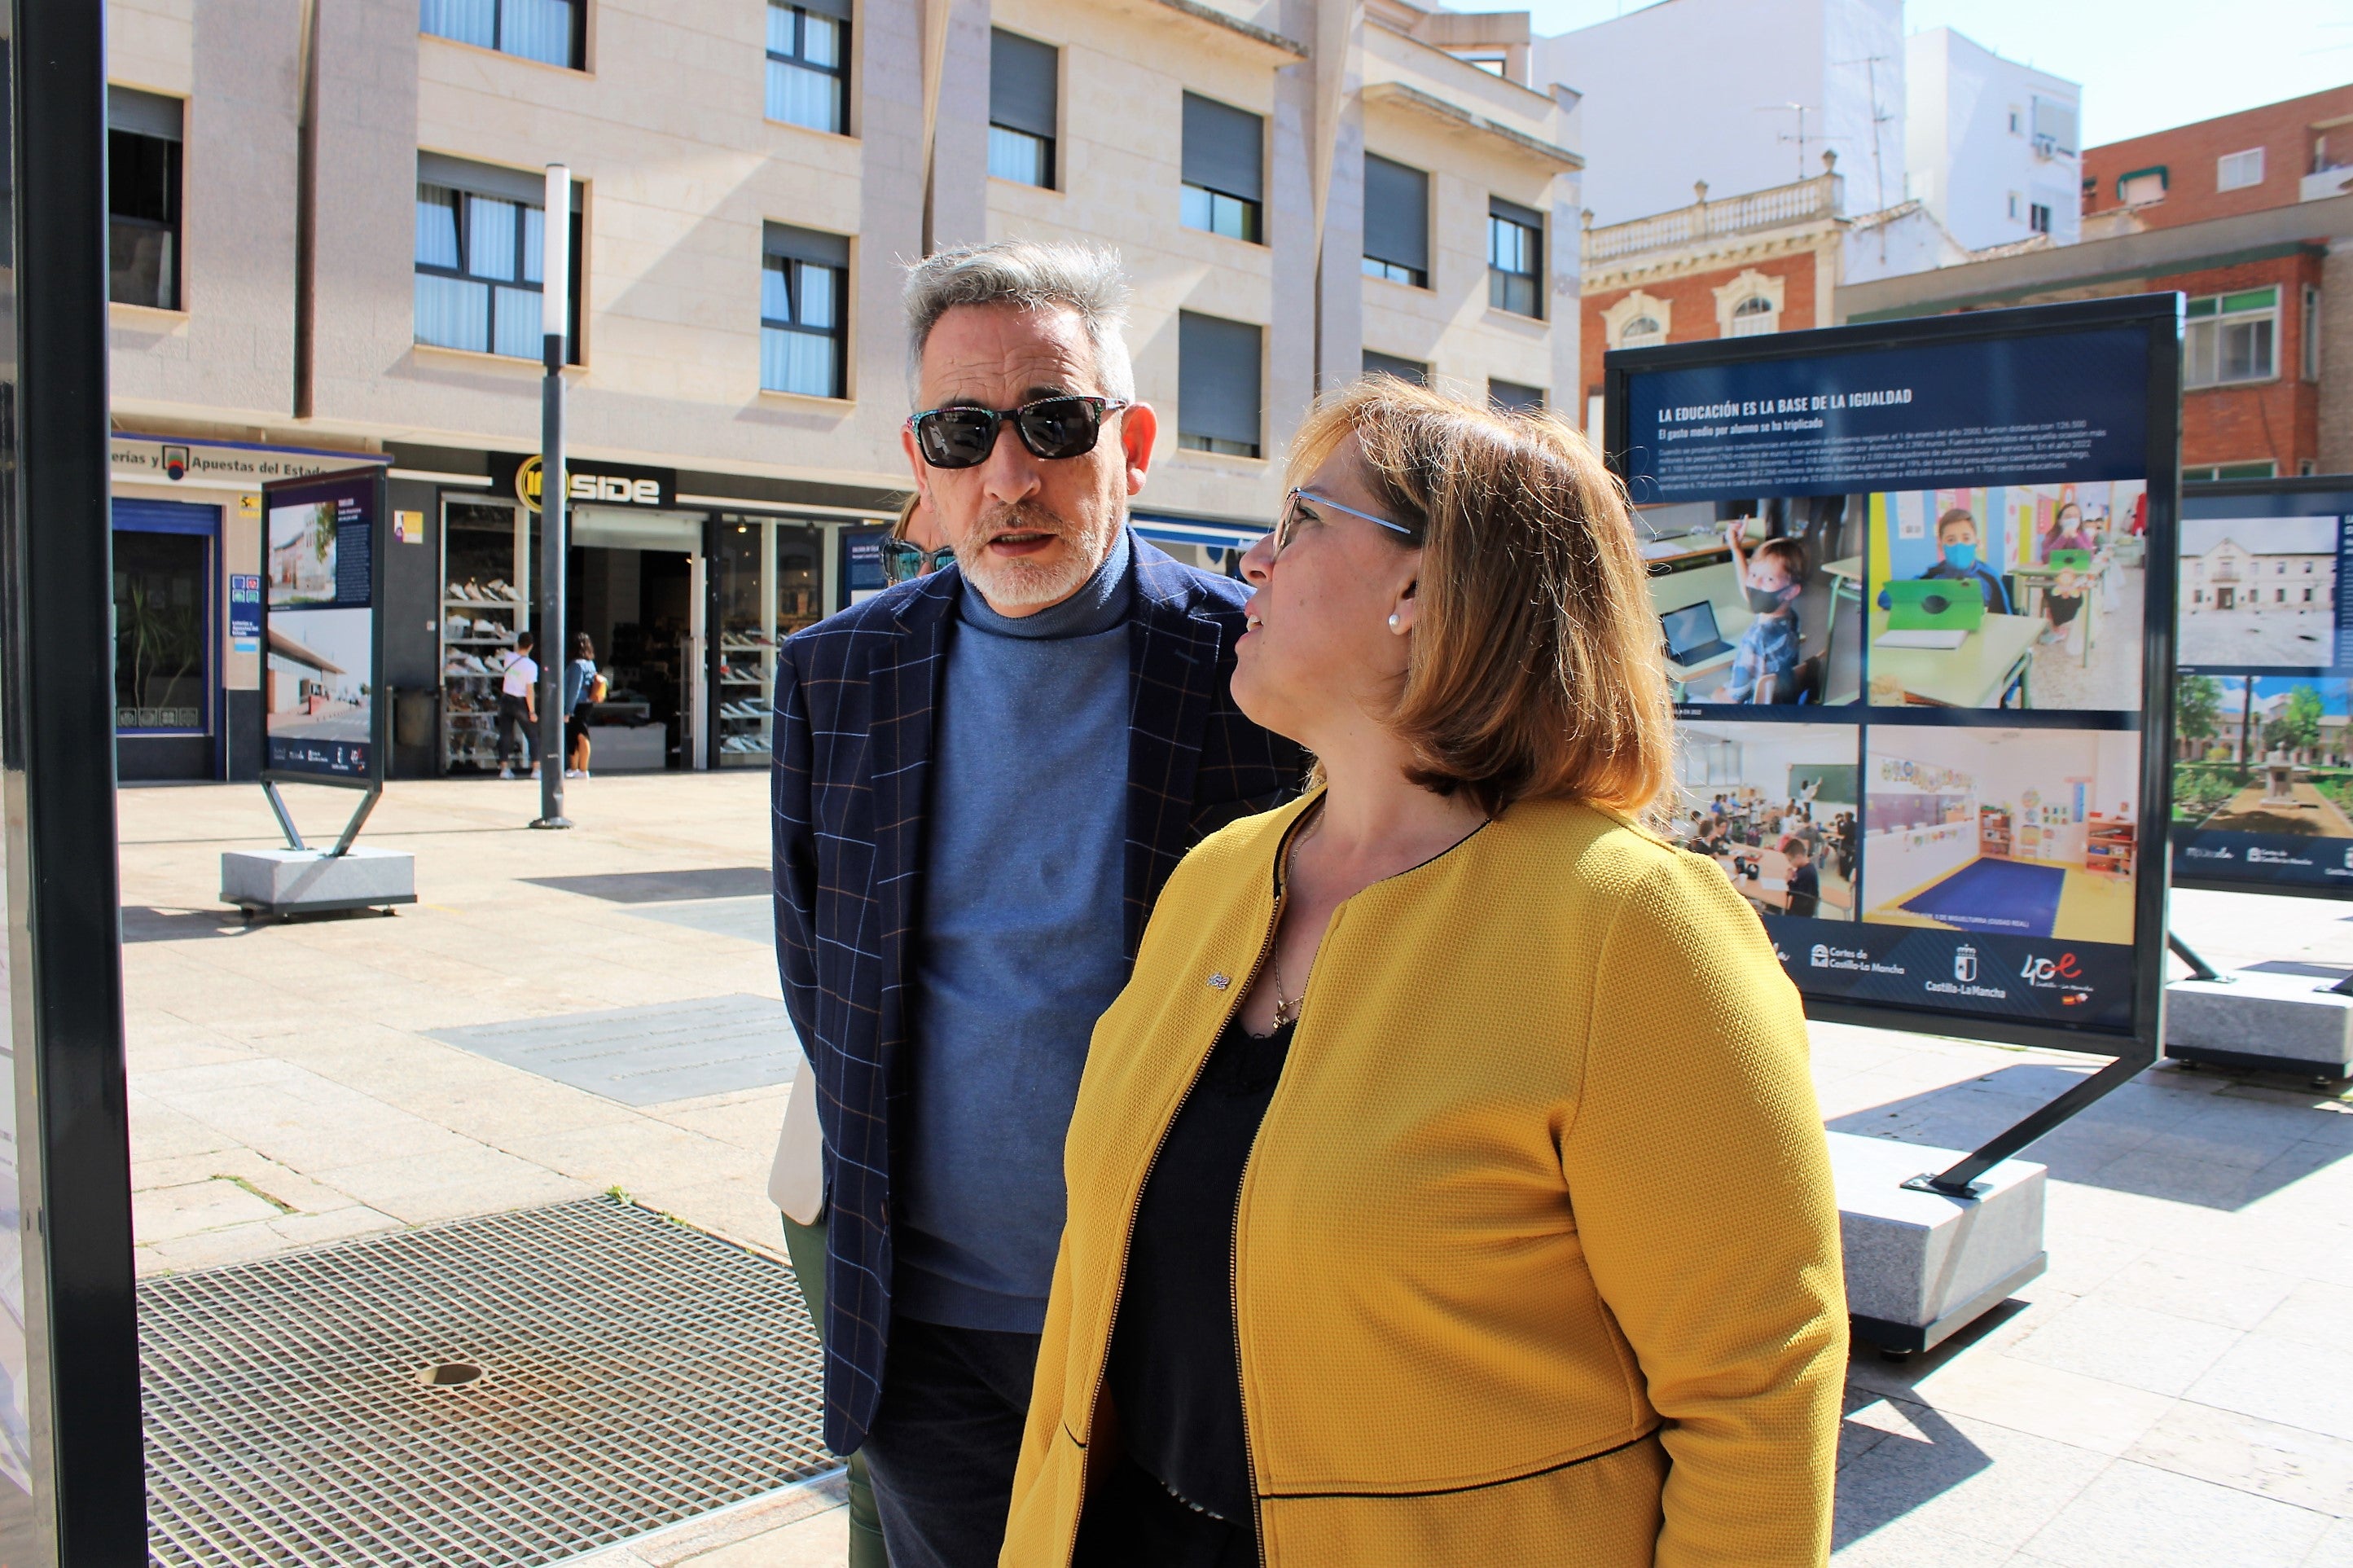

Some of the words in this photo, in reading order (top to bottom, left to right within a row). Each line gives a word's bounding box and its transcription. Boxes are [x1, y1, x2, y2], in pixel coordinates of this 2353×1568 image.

[1658, 409, 1673, 423] LA
[1675, 400, 1740, 422] EDUCACIÓN
[1742, 402, 1757, 416] ES
[1760, 400, 1775, 415] LA
[1778, 397, 1808, 414] BASE
[1811, 395, 1828, 411] DE
[1831, 393, 1846, 410] LA
[1849, 389, 1912, 407] IGUALDAD
[1658, 428, 1666, 440] El
[1667, 428, 1688, 441] gasto
[1689, 425, 1714, 437] medio
[1714, 425, 1728, 437] por
[1730, 423, 1759, 436] alumno
[1760, 422, 1771, 433] se
[1771, 420, 1782, 432] ha
[1784, 417, 1824, 432] triplicado
[112, 450, 146, 464] erías
[151, 457, 159, 468] y
[192, 457, 253, 473] Apuestas
[259, 462, 279, 474] del
[284, 464, 326, 477] Estad
[527, 471, 660, 504] ISIDE
[1829, 947, 1855, 959] Cortes
[1856, 949, 1868, 960] de
[1829, 959, 1870, 972] Castilla-La
[1872, 962, 1905, 975] Mancha
[1972, 986, 2006, 999] Mancha
